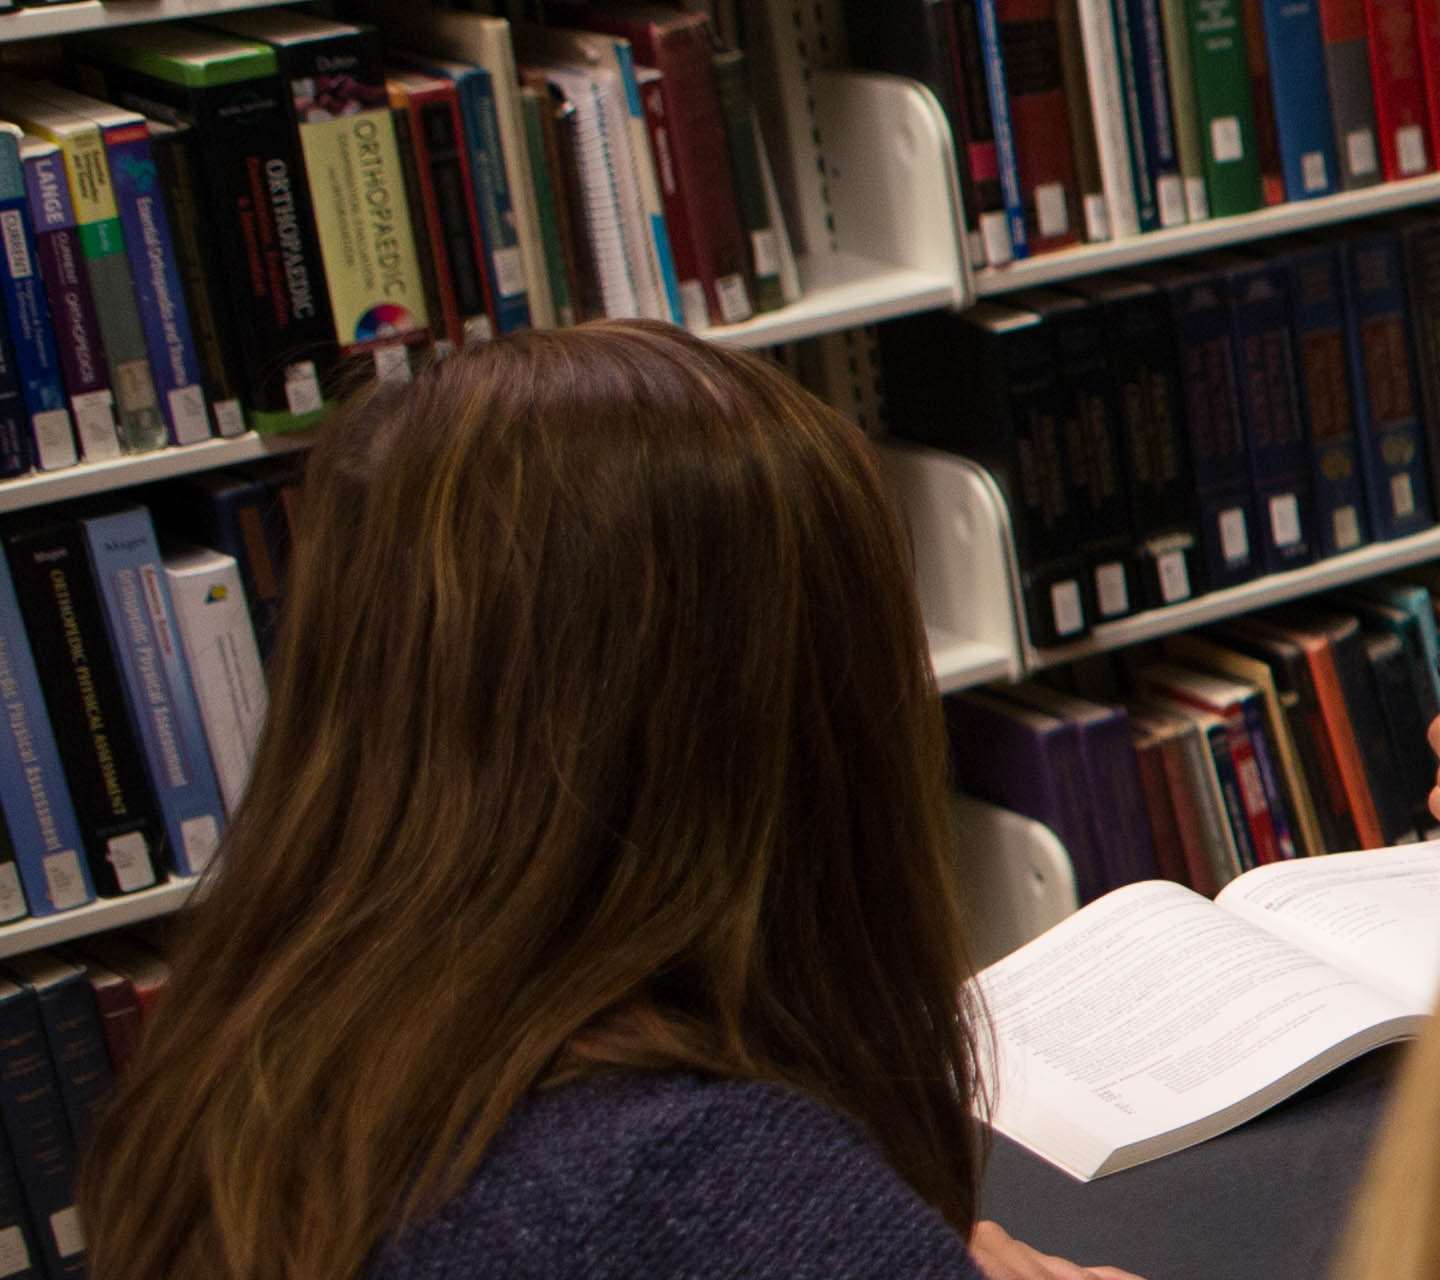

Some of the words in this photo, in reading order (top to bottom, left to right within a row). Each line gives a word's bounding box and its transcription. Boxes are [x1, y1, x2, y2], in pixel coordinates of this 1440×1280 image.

[3, 213, 28, 277] CURRENT
[34, 157, 65, 224] LANGE
[265, 157, 315, 320] ORTHOPAEDIC
[352, 118, 407, 297] ORTHOPAEDIC
[134, 195, 159, 246] Essential
[163, 320, 181, 344] and
[48, 567, 86, 663] ORTHOPEDIC
[73, 665, 104, 731] PHYSICAL
[91, 732, 126, 816] ASSESSMENT
[137, 645, 165, 704] Physical
[152, 706, 186, 786] Assessment
[5, 701, 36, 763] Physical
[24, 765, 60, 849] Assessment
